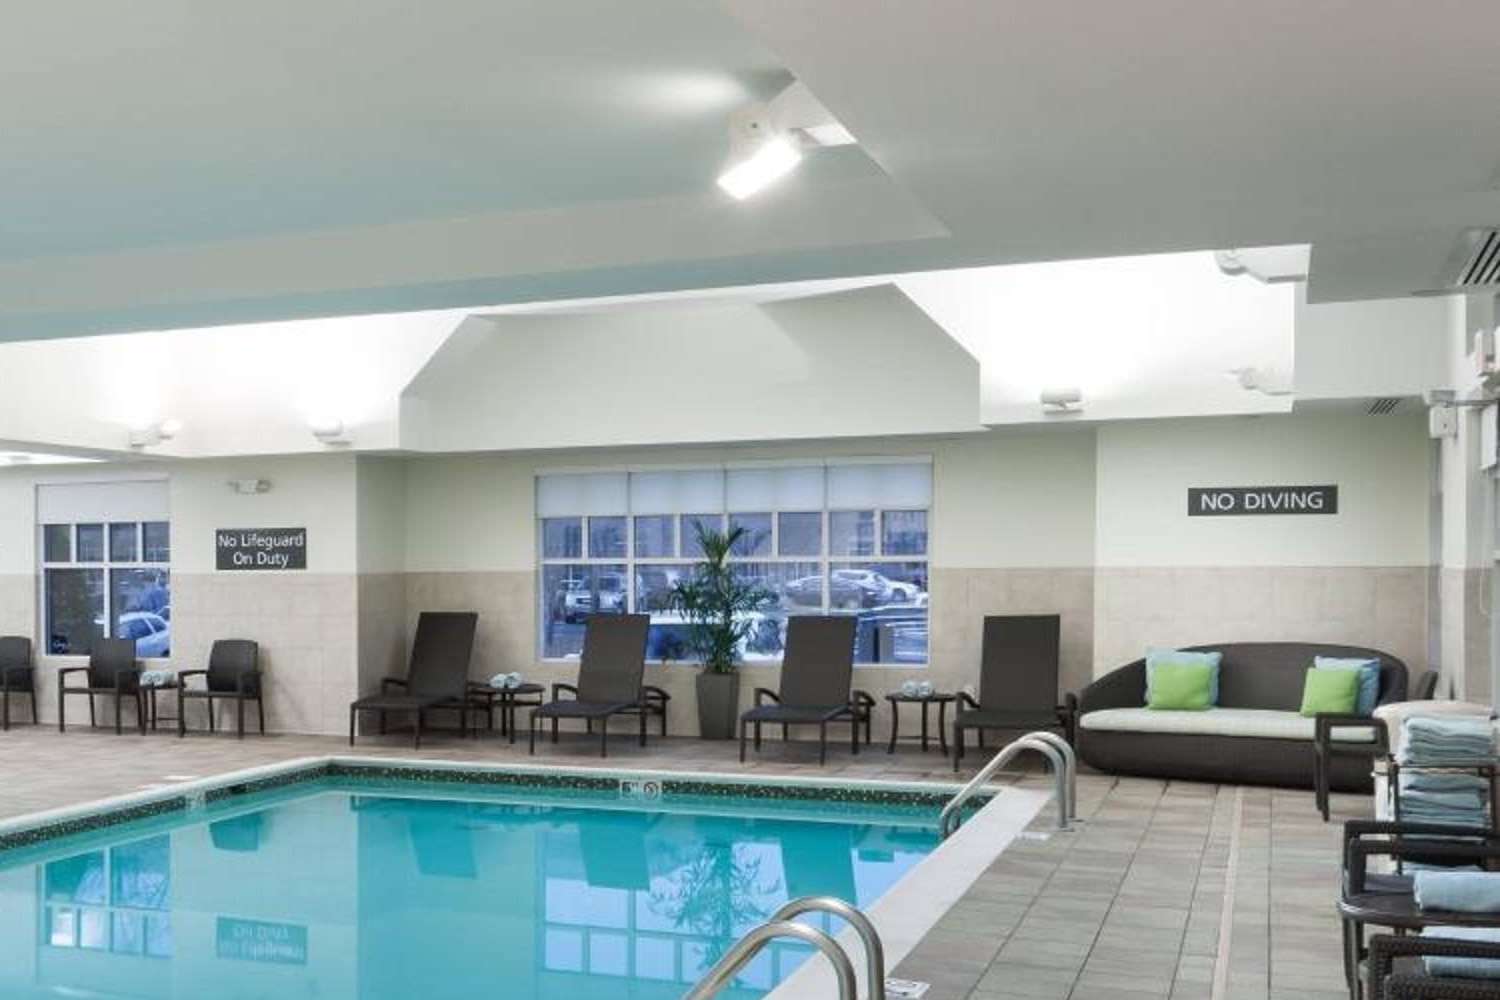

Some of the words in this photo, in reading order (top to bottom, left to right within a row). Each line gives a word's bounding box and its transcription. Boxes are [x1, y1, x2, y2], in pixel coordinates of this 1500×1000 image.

[1201, 492, 1235, 511] NO
[1244, 491, 1324, 510] DIVING
[218, 534, 237, 548] No
[241, 533, 303, 551] Lifeguard
[233, 552, 253, 565] On
[257, 551, 289, 569] Duty
